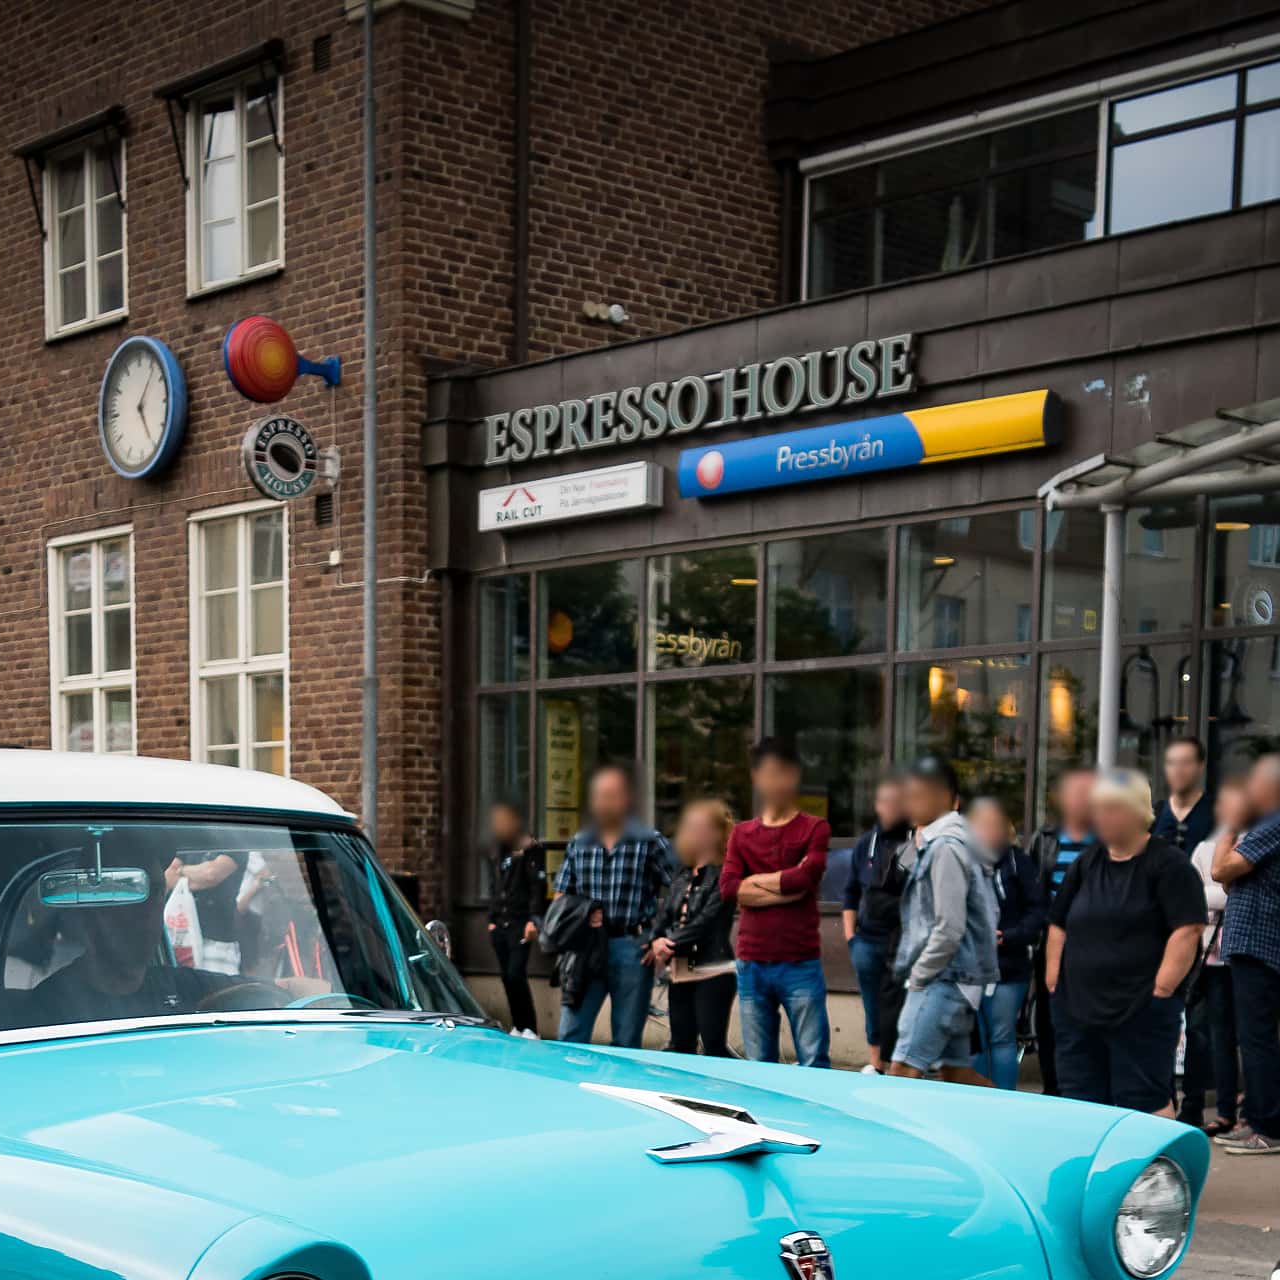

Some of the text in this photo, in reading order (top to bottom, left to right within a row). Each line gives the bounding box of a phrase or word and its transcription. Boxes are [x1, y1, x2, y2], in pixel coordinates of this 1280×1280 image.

[483, 333, 916, 466] ESPRESSO HOUSE
[257, 419, 315, 456] ESPRESSO
[776, 433, 884, 473] Pressbyrån
[263, 471, 307, 494] HOUSE
[496, 504, 544, 523] RAIL CUT
[633, 622, 742, 663] essbyrån
